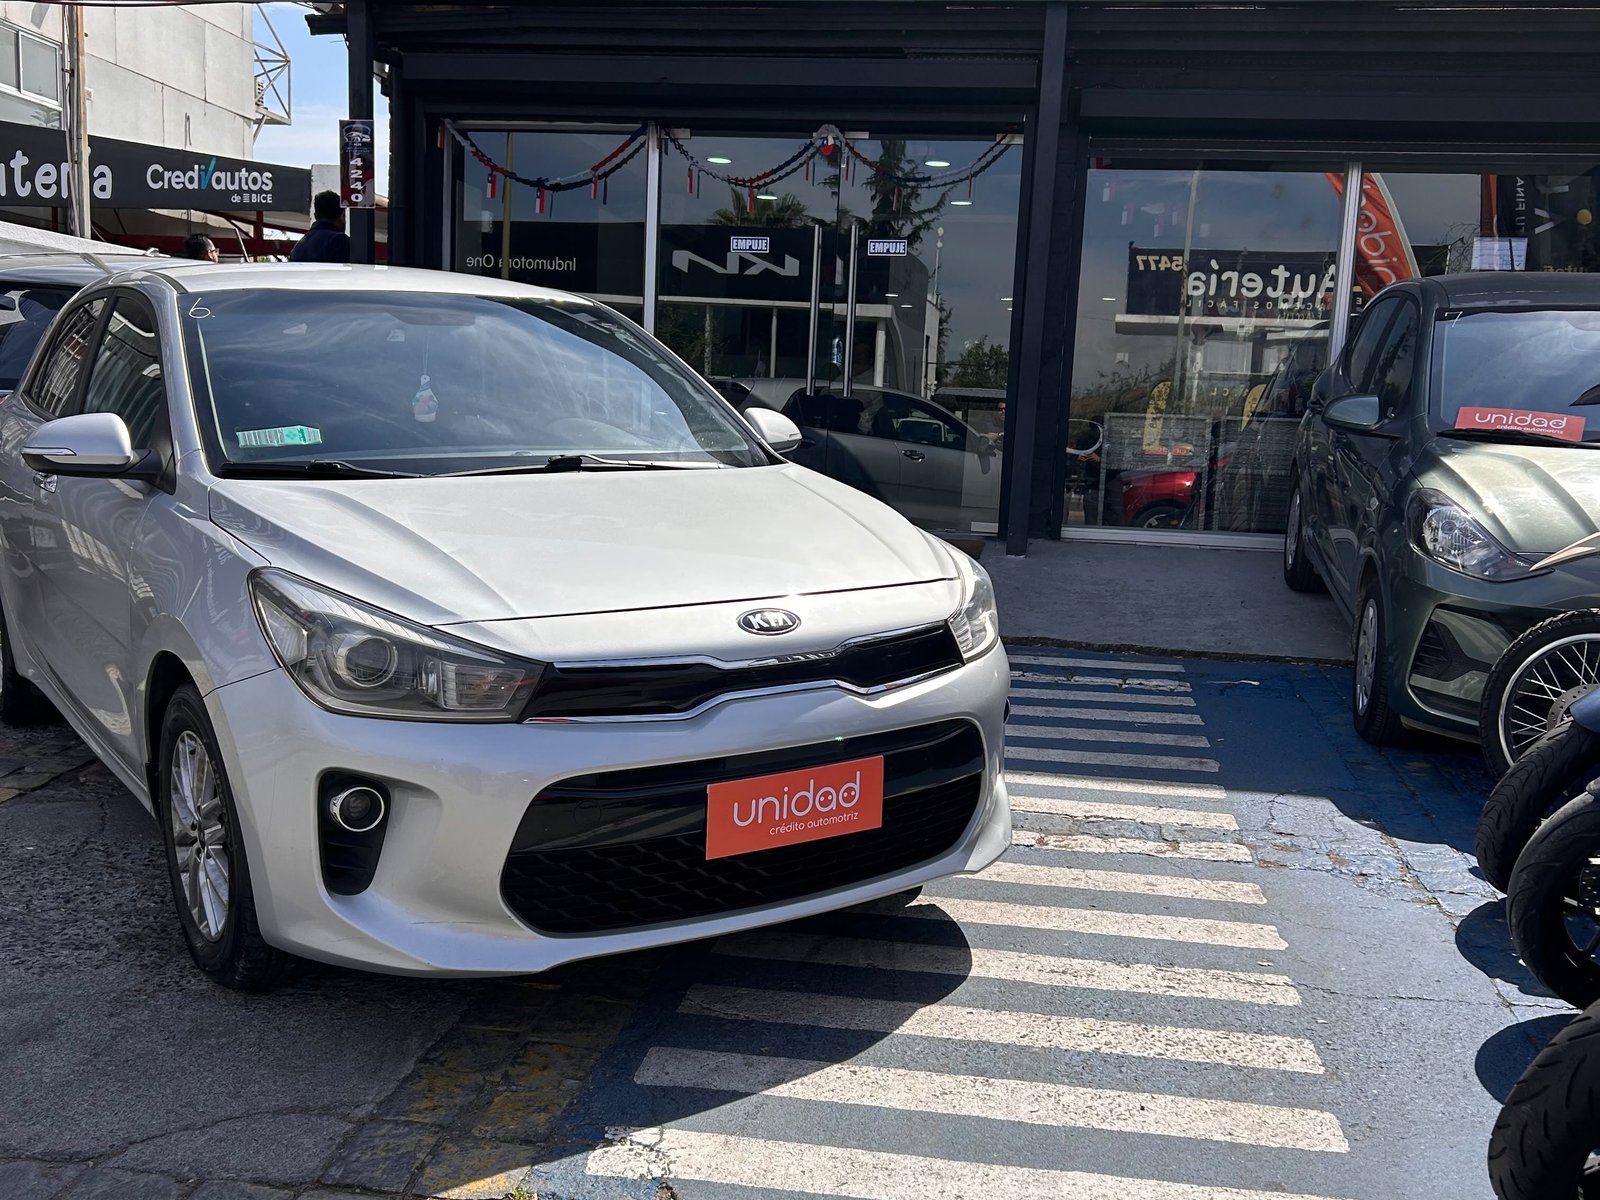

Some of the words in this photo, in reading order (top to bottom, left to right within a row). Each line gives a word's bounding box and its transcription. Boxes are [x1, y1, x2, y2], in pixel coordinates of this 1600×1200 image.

[350, 157, 363, 202] 4240
[231, 193, 241, 203] de
[251, 194, 273, 203] BICE
[732, 239, 768, 251] EMPUJE
[870, 242, 905, 254] EMPUJE
[1445, 311, 1463, 328] 7
[1475, 412, 1568, 429] unidad
[748, 610, 794, 629] KIA
[732, 770, 861, 827] unidad
[769, 821, 805, 836] crédito
[808, 811, 859, 830] automotriz
